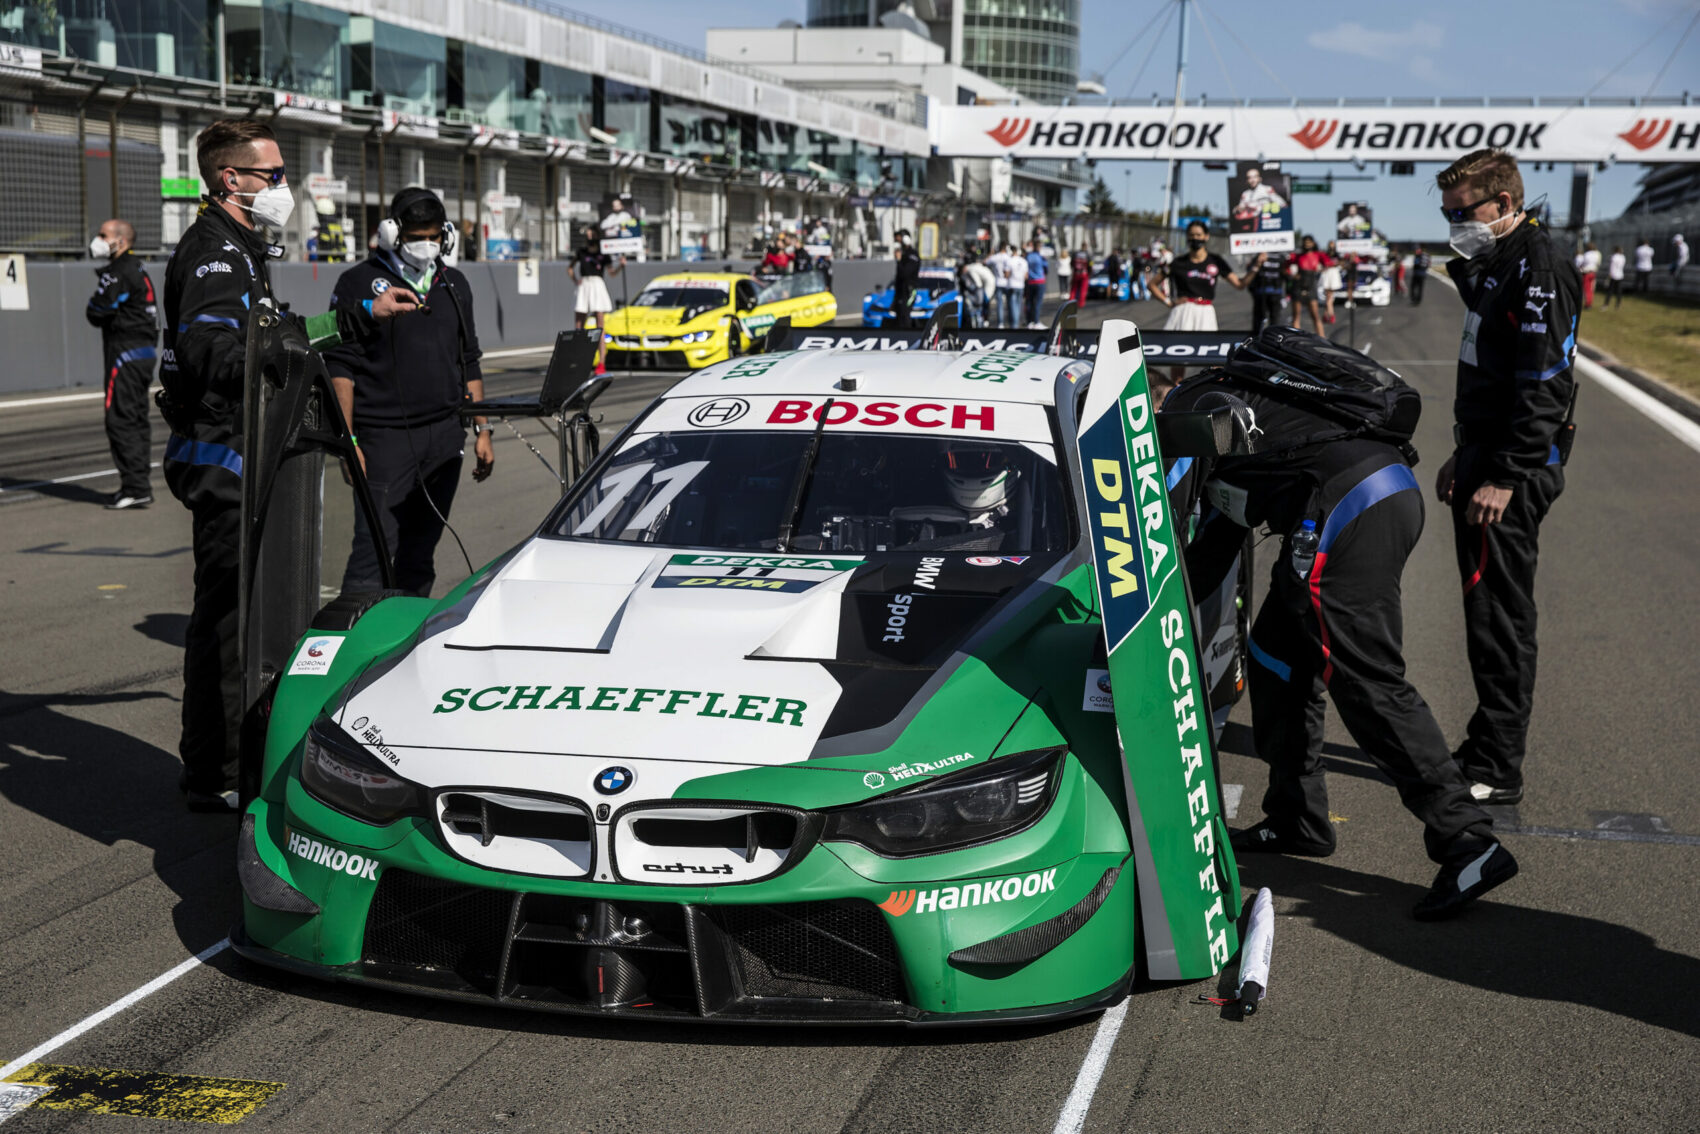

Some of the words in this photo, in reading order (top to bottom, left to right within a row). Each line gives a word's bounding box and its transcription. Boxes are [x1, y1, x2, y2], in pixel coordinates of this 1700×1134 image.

[7, 259, 17, 283] 4
[797, 336, 913, 351] BMW
[765, 400, 995, 432] BOSCH
[1125, 392, 1169, 579] DEKRA
[572, 460, 711, 535] 11
[1092, 458, 1138, 599] DTM
[690, 556, 835, 569] DEKRA
[725, 566, 778, 578] 11
[913, 556, 945, 590] BMW
[677, 577, 788, 590] DTM
[296, 660, 327, 668] CORONA
[432, 685, 808, 727] SCHAEFFLER
[888, 763, 908, 774] Shell
[933, 752, 975, 769] ULTRA
